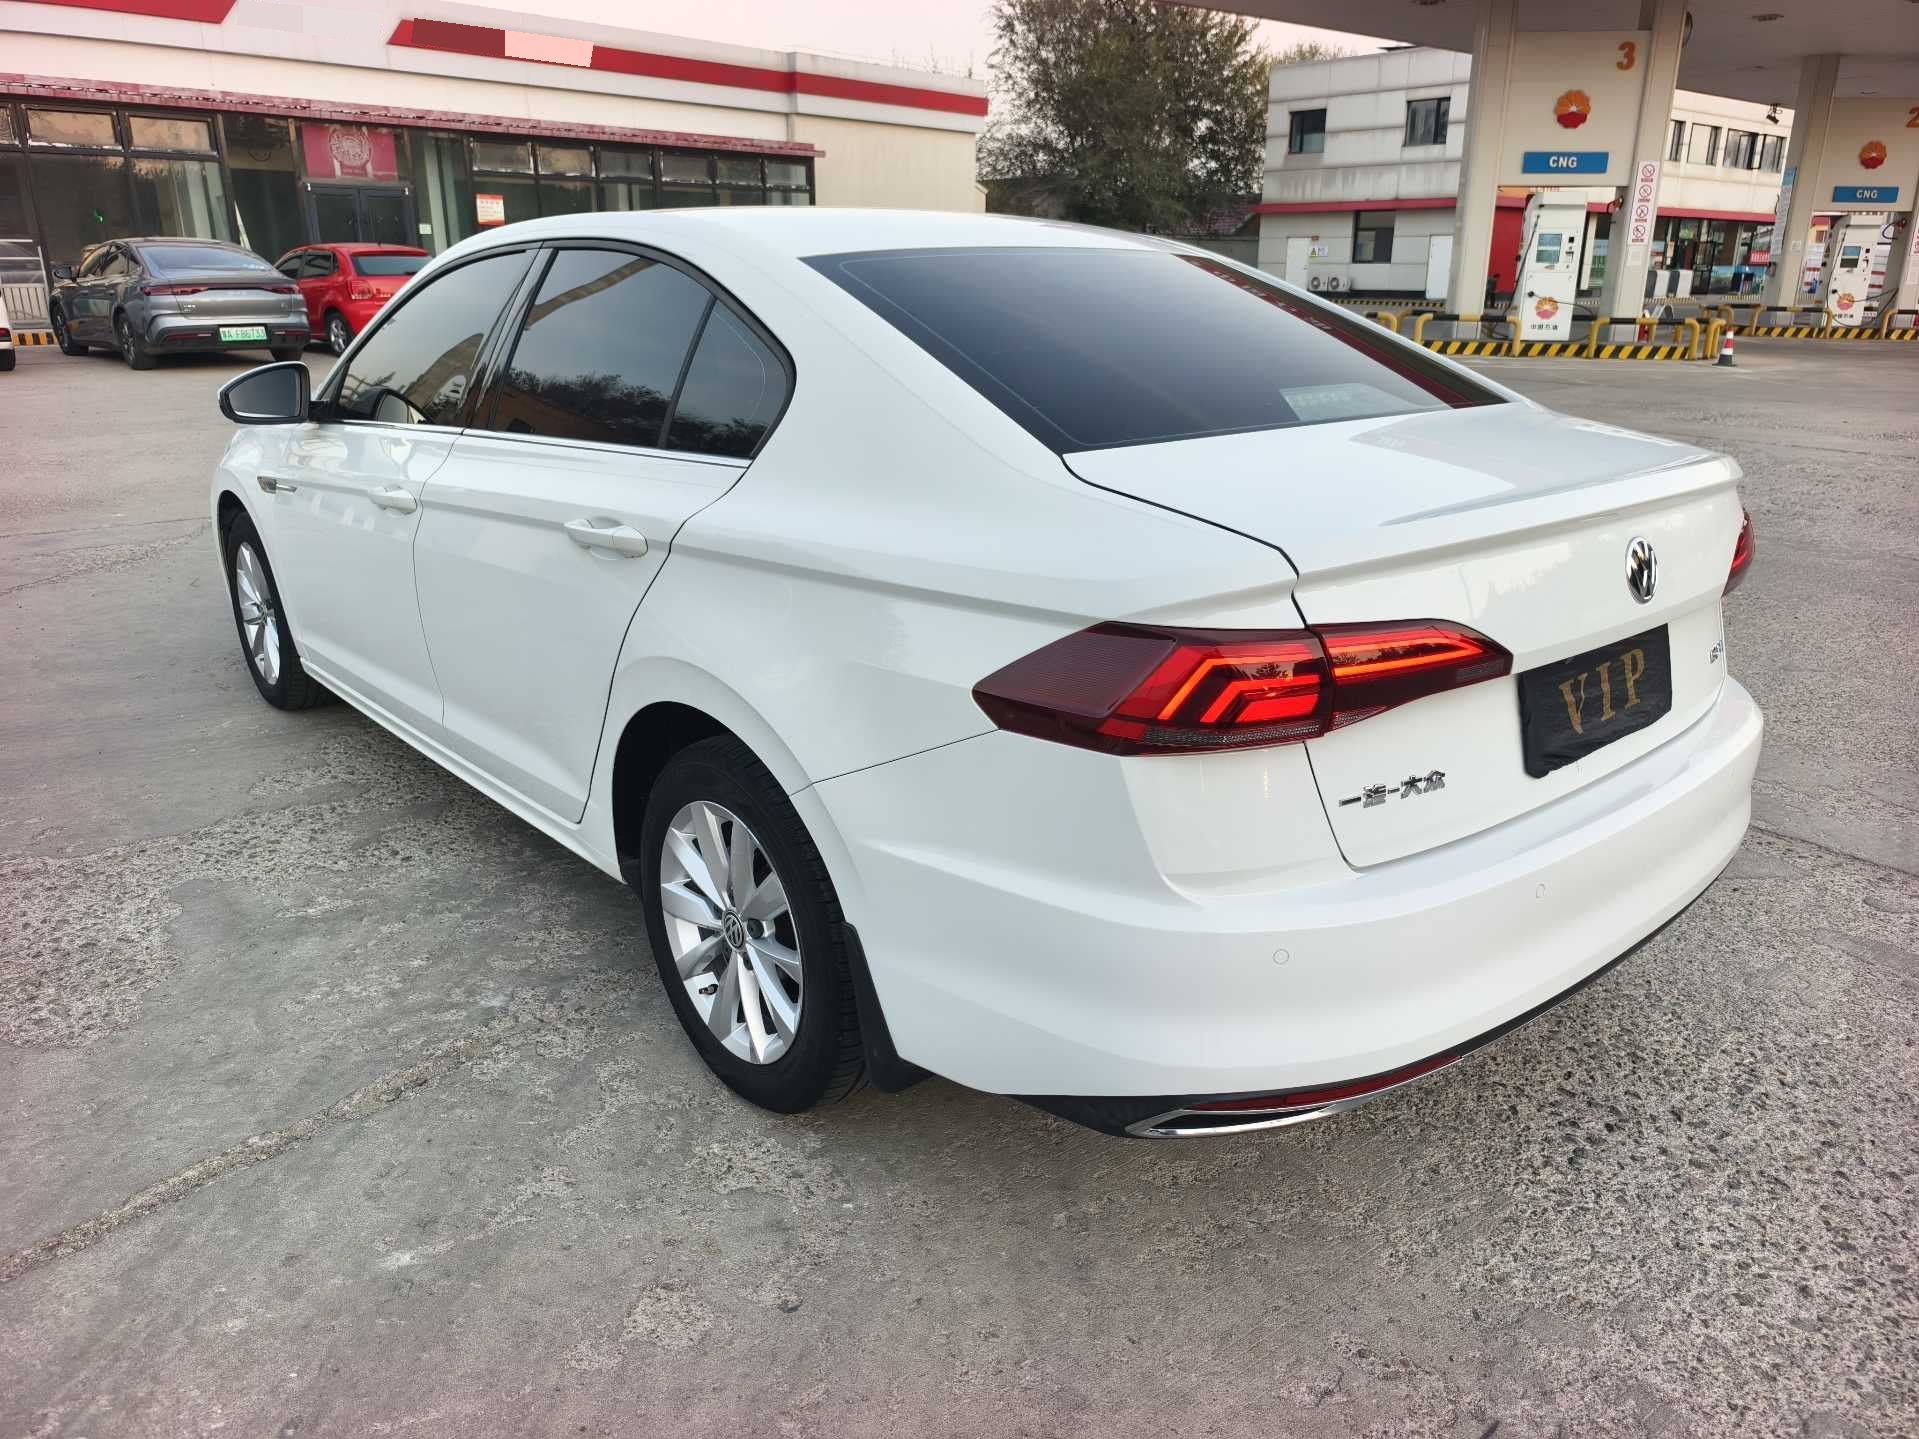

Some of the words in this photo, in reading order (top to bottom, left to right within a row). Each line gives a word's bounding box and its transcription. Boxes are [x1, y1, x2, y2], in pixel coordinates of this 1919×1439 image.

[1616, 41, 1636, 71] 3
[1905, 106, 1919, 129] 2
[1549, 155, 1578, 169] CNG
[1856, 188, 1879, 199] CNG
[1558, 648, 1645, 735] VIP
